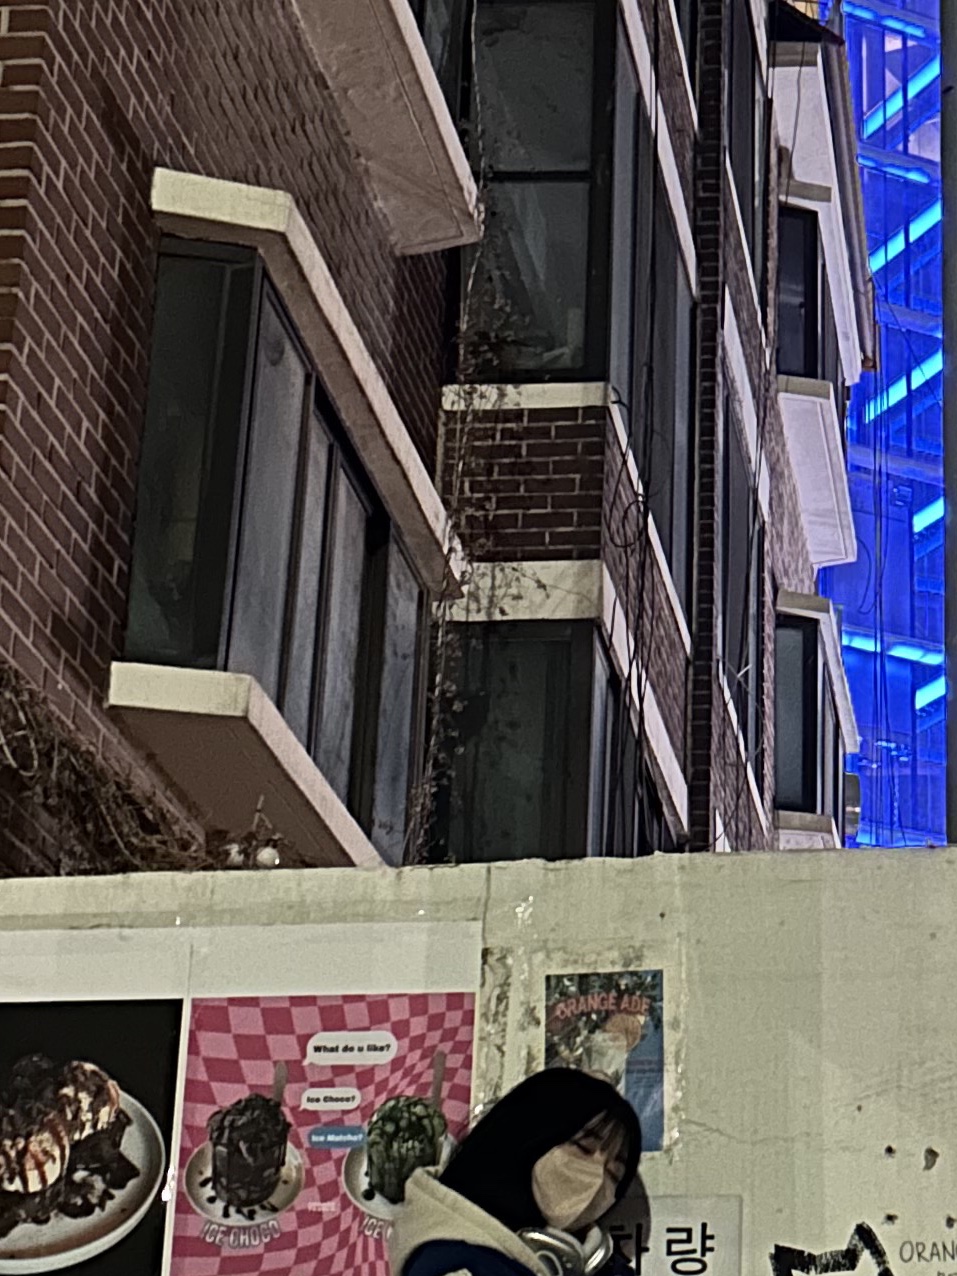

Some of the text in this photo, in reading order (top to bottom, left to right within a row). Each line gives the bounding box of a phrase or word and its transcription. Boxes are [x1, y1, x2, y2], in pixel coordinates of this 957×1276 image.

[553, 991, 651, 1019] ORANGE ADE
[313, 1045, 339, 1053] What
[342, 1045, 355, 1053] do
[366, 1044, 391, 1052] like?
[311, 1134, 325, 1142] Ice
[203, 1220, 281, 1249] ICE CHOCO
[359, 1216, 385, 1239] ICE
